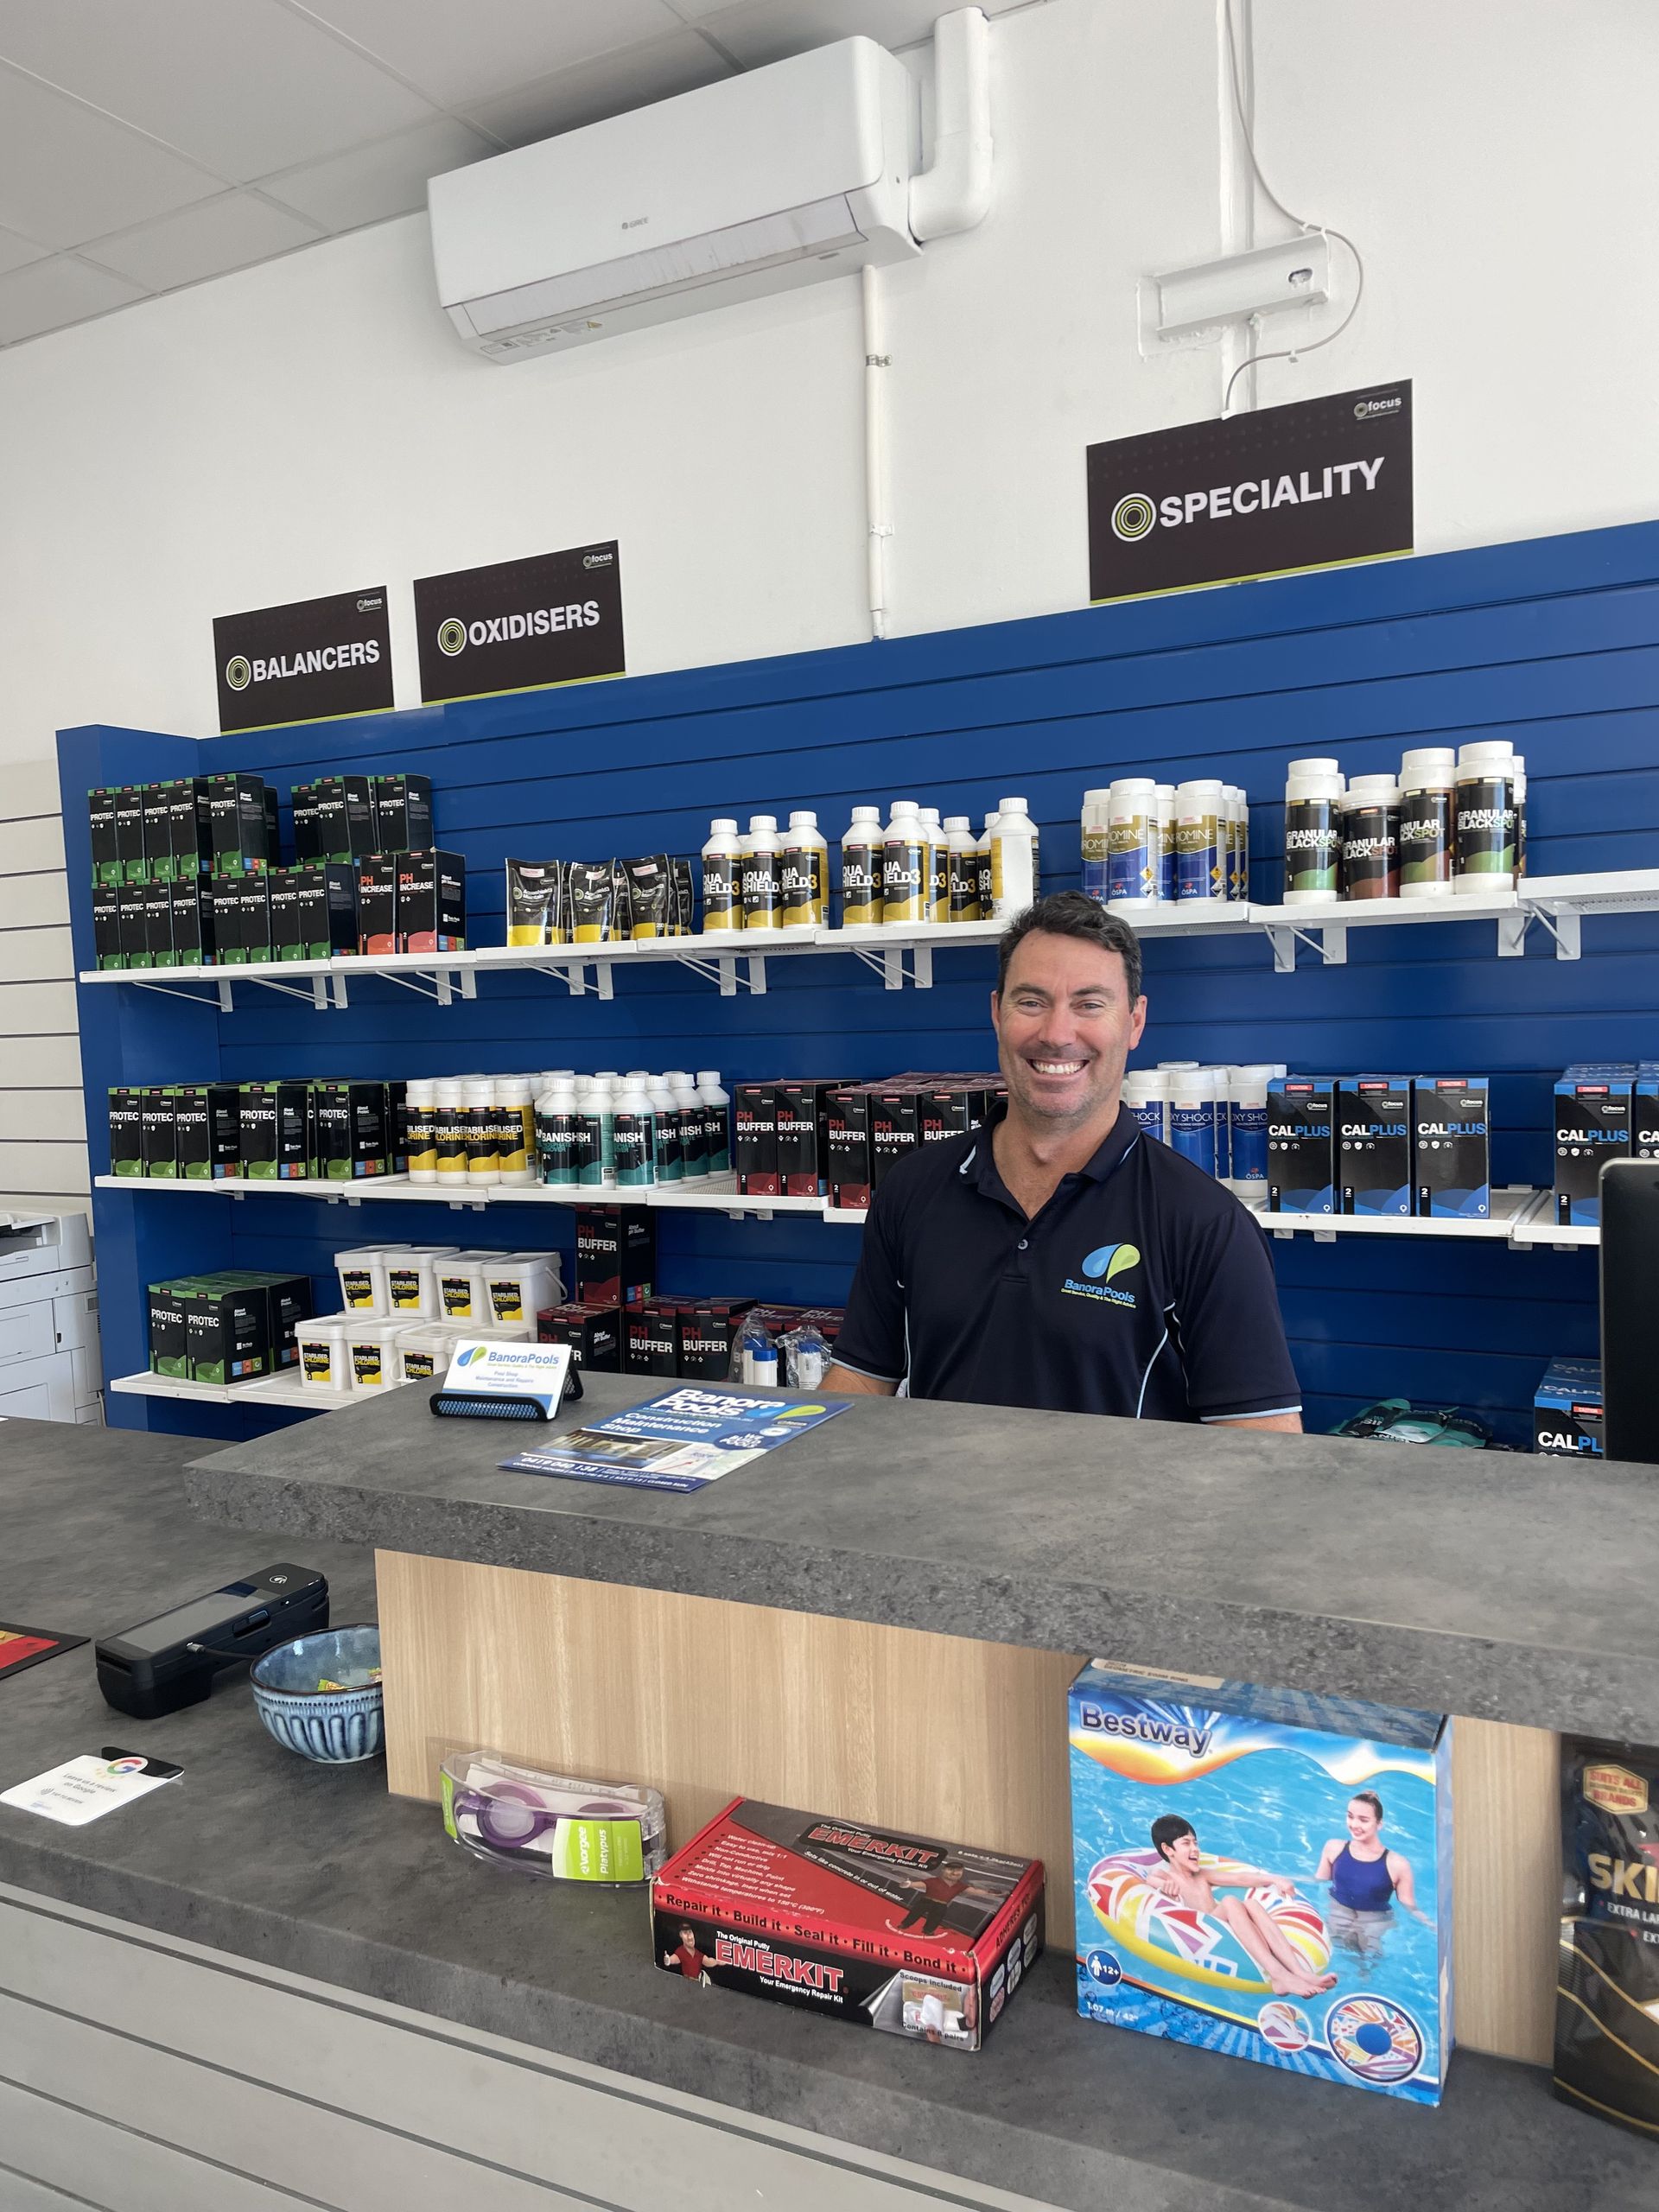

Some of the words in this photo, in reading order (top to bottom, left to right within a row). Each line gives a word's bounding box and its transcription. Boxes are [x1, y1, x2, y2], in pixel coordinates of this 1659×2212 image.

[1368, 396, 1402, 412] focus
[1160, 456, 1384, 527] SPECIALITY
[591, 552, 613, 563] focus
[363, 596, 383, 607] focus
[468, 601, 601, 646] OXIDISERS
[253, 639, 380, 682] BALANCERS
[170, 803, 194, 812] PROTEC
[210, 799, 236, 809] PROTEC
[318, 801, 344, 810] PROTEC
[379, 799, 404, 808] PROTEC
[118, 809, 141, 818] PROTEC
[144, 806, 168, 816] PROTEC
[294, 808, 319, 817] PROTEC
[1458, 809, 1515, 821] GRANULAR
[90, 812, 114, 822] PROTEC
[1286, 830, 1338, 841] GRANULAR
[360, 876, 373, 885] PH
[399, 874, 414, 883] PH
[360, 885, 392, 893] INCREASE
[399, 882, 434, 892] INCREASE
[271, 892, 296, 901] PROTEC
[299, 889, 325, 899] PROTEC
[173, 899, 197, 908] PROTEC
[213, 897, 239, 906] PROTEC
[240, 895, 265, 905] PROTEC
[93, 905, 117, 914] PROTEC
[120, 903, 144, 912] PROTEC
[146, 901, 169, 911] PROTEC
[109, 1112, 139, 1122] PROTEC
[142, 1113, 174, 1122] PROTEC
[176, 1113, 207, 1122] PROTEC
[240, 1110, 276, 1121] PROTEC
[319, 1109, 348, 1119] PROTEC
[736, 1111, 753, 1122] PH
[778, 1111, 793, 1121] PH
[1181, 1113, 1213, 1122] SHOCK
[736, 1122, 774, 1132] BUFFER
[778, 1122, 813, 1131] BUFFER
[829, 1120, 844, 1130] PH
[874, 1122, 893, 1132] PH
[924, 1120, 943, 1130] PH
[1341, 1124, 1408, 1136] CALPLUS
[1417, 1122, 1487, 1135] CALPLUS
[829, 1130, 866, 1141] BUFFER
[1268, 1125, 1331, 1137] CALPLUS
[1557, 1129, 1629, 1142] CALPLUS
[874, 1133, 915, 1142] BUFFER
[577, 1225, 594, 1237] PH
[577, 1237, 617, 1251] BUFFER
[1065, 1279, 1135, 1303] BanoraPools
[150, 1308, 183, 1324] PROTEC
[187, 1314, 220, 1328] PROTEC
[630, 1325, 648, 1338] PH
[682, 1326, 702, 1339] PH
[629, 1338, 673, 1353] BUFFER
[682, 1340, 728, 1352] BUFFER
[488, 1351, 559, 1364] BanoraPools
[650, 1398, 745, 1416] Pools
[611, 1418, 709, 1433] Maintenance
[625, 1413, 722, 1428] Construction
[601, 1424, 642, 1433] Shop
[1081, 1702, 1211, 1757] Bestway
[1590, 1770, 1620, 1786] SUITS
[1623, 1776, 1643, 1790] ALL
[1593, 1789, 1637, 1808] BRANDS
[579, 1826, 590, 1868] vorgee
[807, 1827, 938, 1863] EMERKIT
[600, 1828, 610, 1875] Platypus
[861, 1850, 895, 1864] Emergency
[896, 1859, 918, 1867] Repair
[804, 1851, 817, 1860] Sets
[829, 1861, 854, 1878] concrete
[868, 1881, 878, 1890] out
[885, 1890, 905, 1902] water
[1588, 1853, 1659, 1904] SKI
[1607, 1902, 1640, 1920] EXTRA
[666, 1894, 709, 1917] Repair
[711, 1903, 721, 1916] it
[734, 1910, 768, 1929] Build
[772, 1917, 782, 1932] it
[794, 1923, 825, 1942] Seal
[829, 1932, 839, 1945] it
[853, 1938, 874, 1954] Fill
[880, 1943, 889, 1957] it
[904, 1952, 941, 1971] Bond
[946, 1960, 957, 1974] it
[716, 1931, 728, 1940] The
[729, 1935, 753, 1947] Original
[753, 1940, 770, 1951] Putty
[715, 1939, 844, 1993] EMERKIT
[1103, 1965, 1119, 1975] 12+
[899, 1972, 927, 1985] Scoops
[930, 1978, 963, 1992] included
[760, 1975, 775, 1986] Your
[775, 1980, 810, 1998] Emergency
[811, 1989, 832, 2001] Repair
[834, 1994, 843, 2004] Kit
[1087, 2002, 1103, 2012] 1.07
[944, 2031, 964, 2042] pairs
